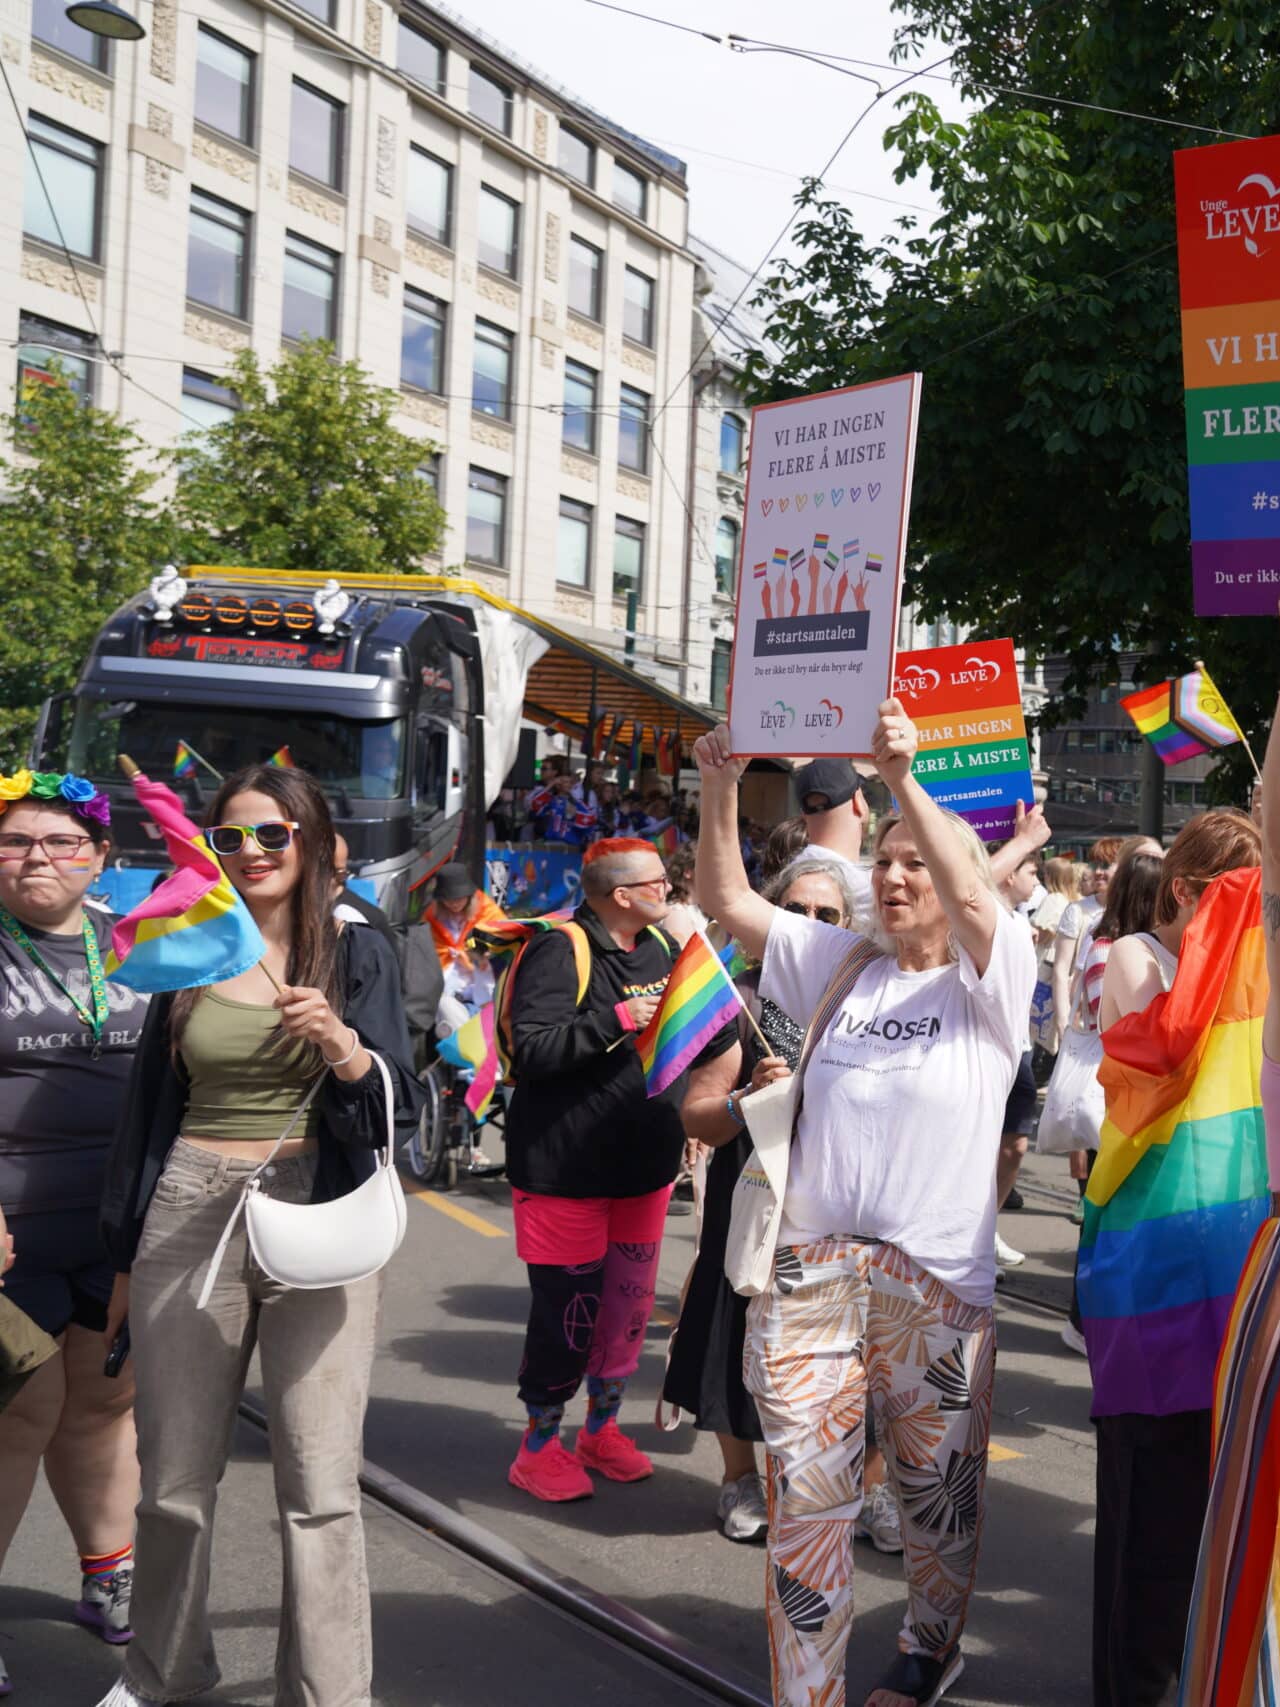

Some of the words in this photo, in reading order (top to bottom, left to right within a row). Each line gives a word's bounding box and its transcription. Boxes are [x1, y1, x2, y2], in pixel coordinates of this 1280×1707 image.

[1200, 199, 1228, 212] Unge
[1205, 203, 1280, 240] LEVE
[1206, 336, 1242, 365] VI
[774, 430, 791, 448] VI
[795, 422, 828, 444] HAR
[833, 410, 885, 437] INGEN
[768, 454, 815, 478] FLERE
[819, 445, 829, 470] Å
[835, 442, 886, 467] MISTE
[1215, 571, 1234, 584] Du
[1238, 573, 1253, 583] er
[766, 625, 856, 645] #startsamtalen
[754, 666, 764, 676] Du
[772, 665, 786, 675] ikke
[787, 664, 795, 674] til
[795, 664, 807, 676] bry
[808, 663, 820, 673] når
[821, 663, 830, 672] du
[832, 662, 848, 674] bryr
[950, 669, 988, 685] LEVE
[760, 715, 786, 729] LEVE
[804, 713, 833, 727] LEVE
[919, 726, 954, 743] HAR
[959, 719, 1012, 737] INGEN
[911, 757, 948, 774] ERE
[953, 751, 964, 769] Å
[968, 748, 1021, 767] MISTE
[932, 787, 1003, 802] startsamtalen
[17, 1033, 75, 1051] BACK
